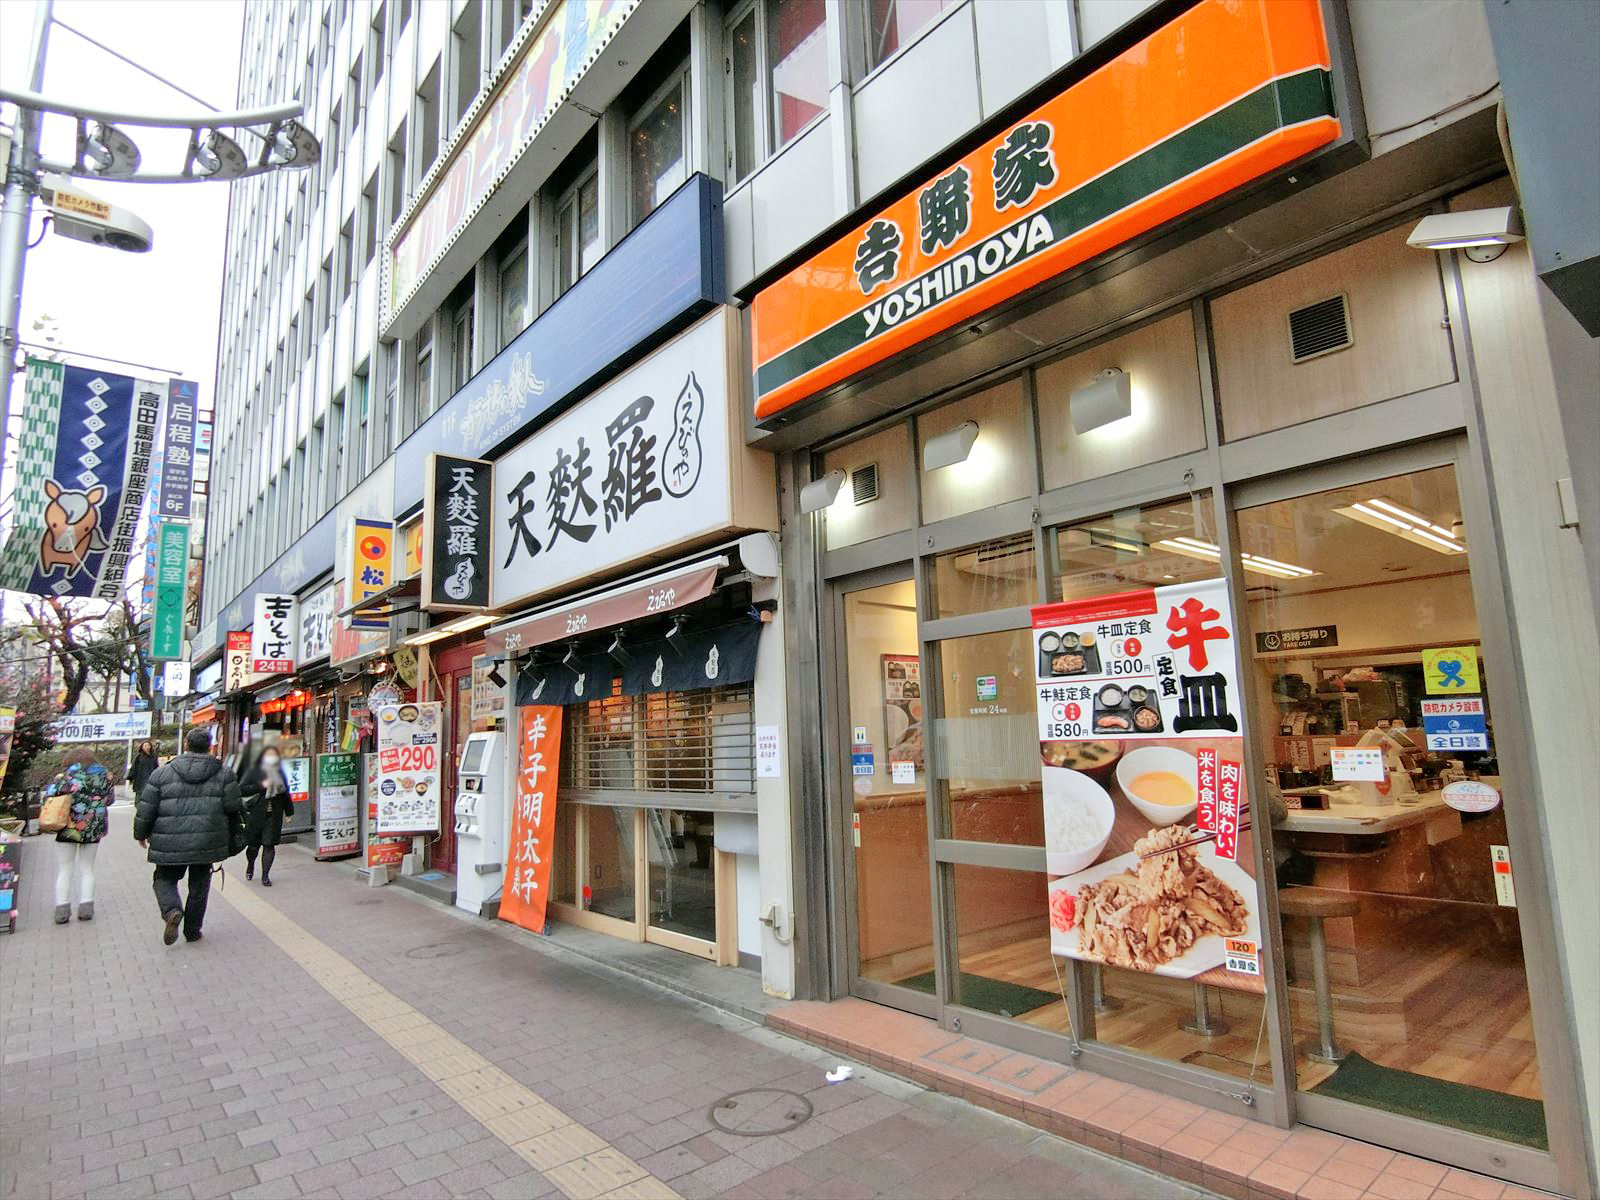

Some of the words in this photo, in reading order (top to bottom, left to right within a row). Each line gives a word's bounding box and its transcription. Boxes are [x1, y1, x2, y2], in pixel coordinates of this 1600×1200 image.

[855, 122, 1057, 294] 吉野家
[863, 214, 1053, 337] YOSHINOYA
[100, 391, 161, 600] 高田馬場銀座商店街振興組合
[166, 499, 184, 512] 6F
[162, 531, 184, 584] 美容室
[263, 596, 292, 659] 吉そば
[1097, 619, 1152, 639] 牛皿定食
[1282, 629, 1328, 642] お持ち帰り
[258, 661, 275, 672] 24
[1156, 656, 1178, 697] 定食
[1166, 597, 1238, 734] 牛皿
[1040, 686, 1092, 702] 牛鮭定食
[1424, 701, 1480, 713] 防犯カメラ設置
[1432, 736, 1480, 748] 全日警
[521, 714, 547, 904] 辛子明太子
[1198, 752, 1216, 830] 米を食う。
[1217, 764, 1239, 857] 肉を味わい、
